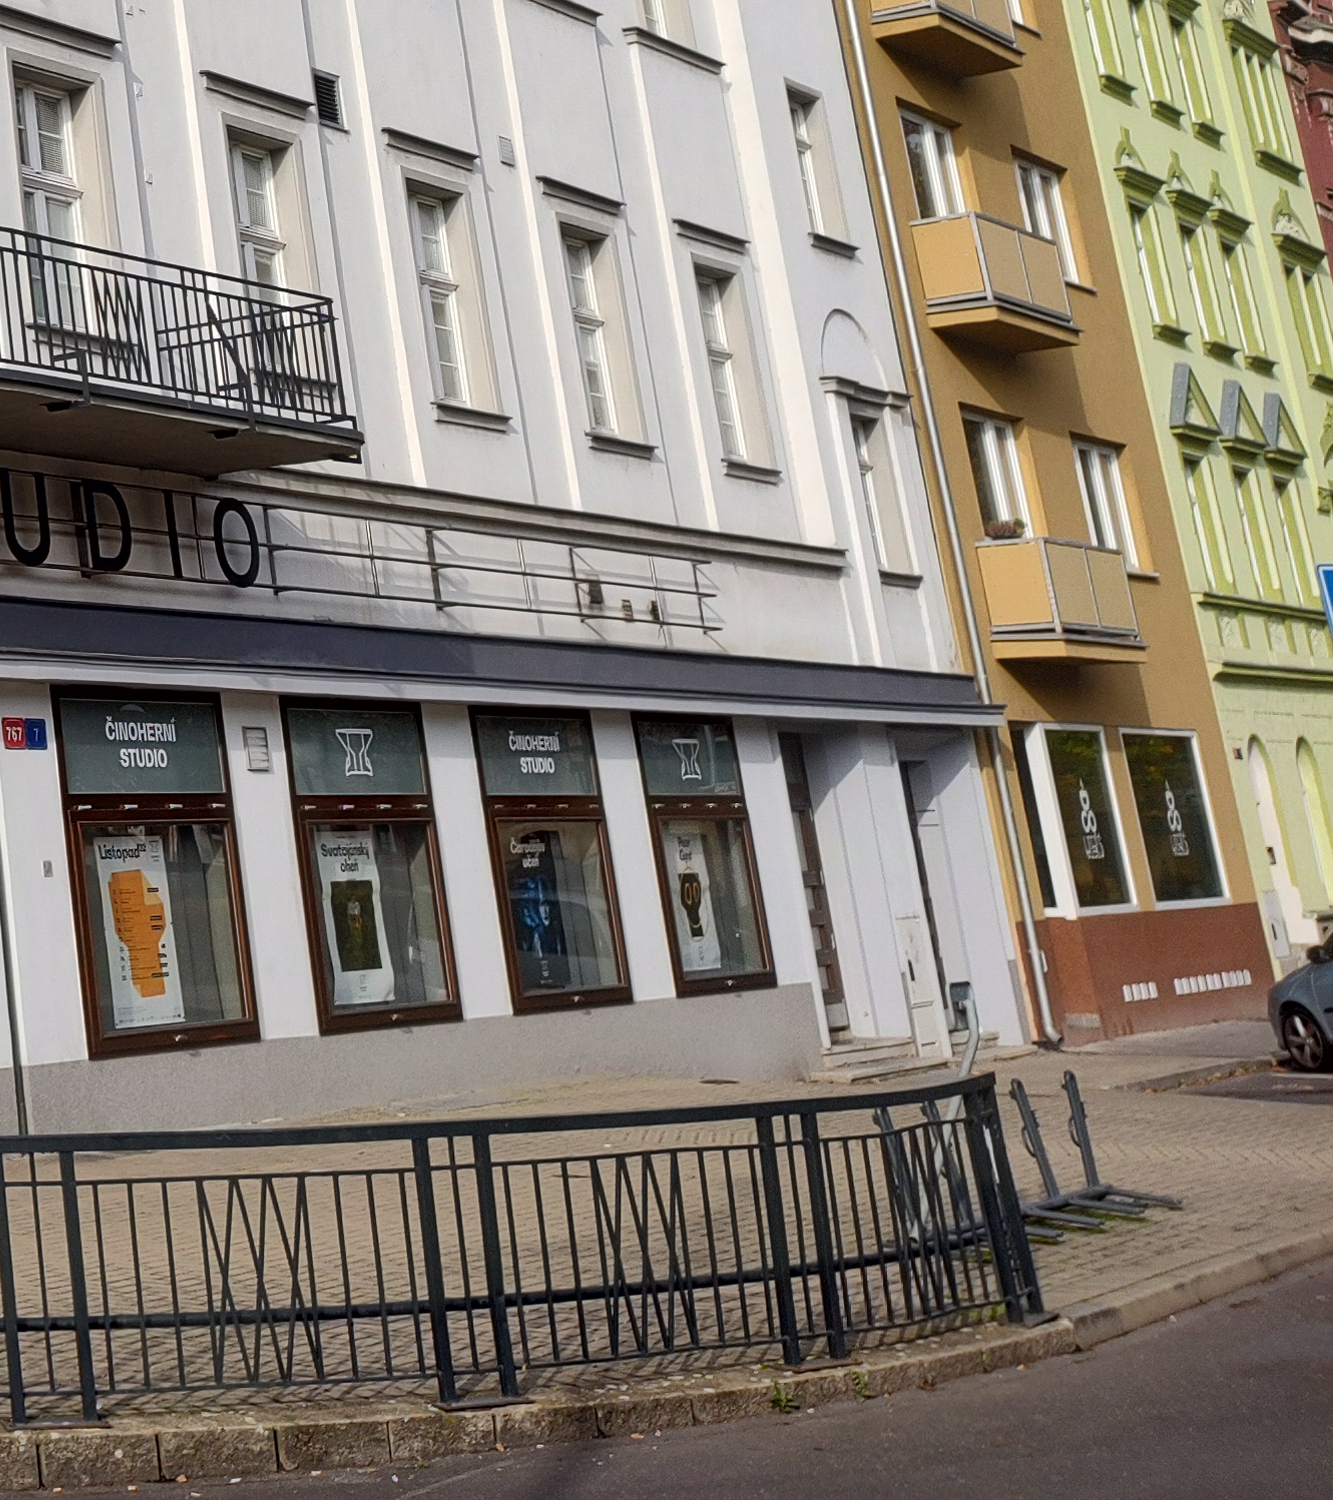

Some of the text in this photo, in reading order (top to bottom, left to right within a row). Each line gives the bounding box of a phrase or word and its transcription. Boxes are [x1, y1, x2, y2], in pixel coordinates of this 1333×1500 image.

[6, 726, 23, 742] 767
[33, 728, 39, 742] 7
[105, 716, 177, 742] ČINOHERNÍ
[508, 730, 560, 752] ČINOHERNÍ
[119, 748, 168, 768] STUDIO
[520, 757, 555, 774] STUDIO
[98, 843, 140, 863] Listopad
